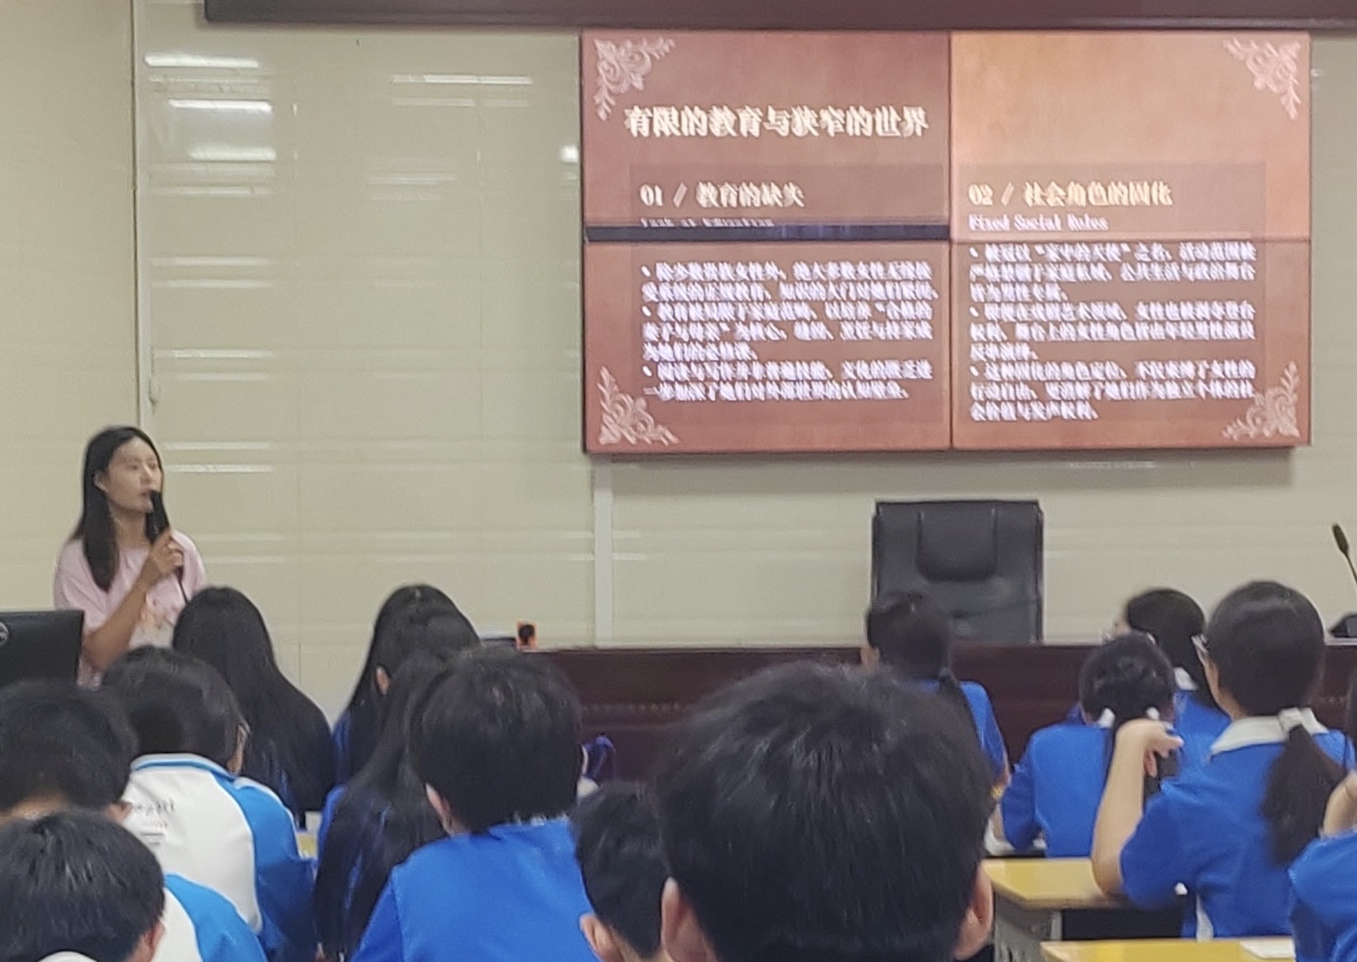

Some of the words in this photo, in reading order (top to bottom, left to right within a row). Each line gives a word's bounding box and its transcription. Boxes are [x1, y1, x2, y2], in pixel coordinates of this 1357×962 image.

[624, 105, 930, 138] 有限的教育与狭窄的世界
[640, 183, 664, 208] 01
[696, 181, 806, 208] 教育的缺失
[968, 182, 993, 207] 02
[1023, 181, 1174, 208] 社会角色的固化
[1014, 213, 1062, 231] Social
